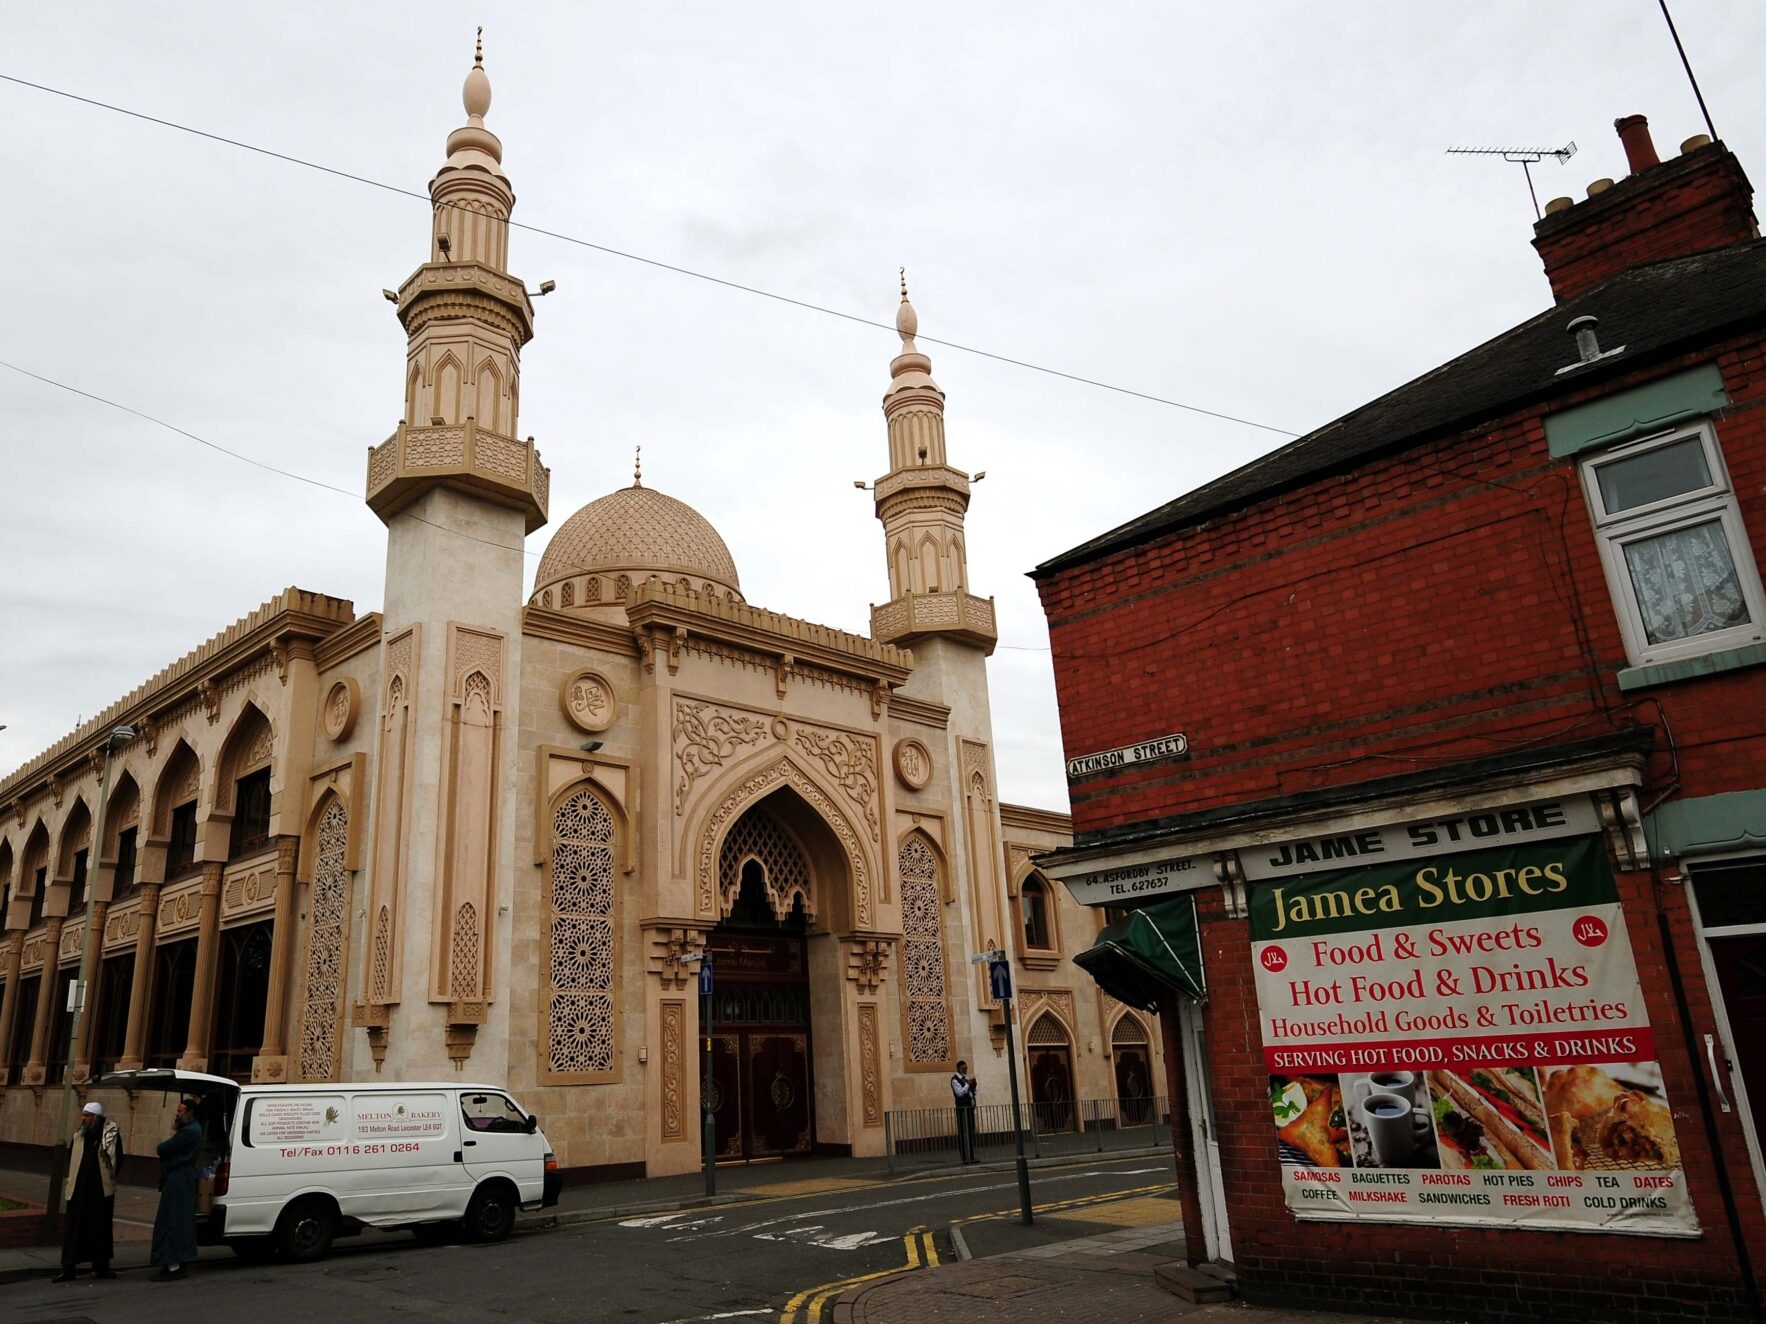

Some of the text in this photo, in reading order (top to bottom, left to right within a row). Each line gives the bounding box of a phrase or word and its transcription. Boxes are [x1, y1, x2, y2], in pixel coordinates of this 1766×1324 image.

[1071, 738, 1180, 775] ATKINSON STREET
[1269, 803, 1567, 868] JAME STORE
[1271, 862, 1568, 932] Jamea Stores
[1311, 922, 1542, 967] Food & Sweets
[1288, 957, 1589, 1007] Hot Food & Drinks
[1270, 998, 1628, 1038] Household Goods & Toiletries
[1274, 1036, 1637, 1068] SERVING HOT FOOD, SNACKS & DRINKS
[370, 1125, 386, 1133] Melton
[401, 1124, 422, 1132] Leicester
[411, 1111, 442, 1119] BAKERY
[280, 1143, 420, 1158] Tel/Fax 0116 261 0264
[1293, 1170, 1674, 1188] SAMOSAS BAGUETTES PAROTAS HOT PIES CHIPS TEA DATES
[1302, 1188, 1667, 1209] COFFEE MILKSHAKE SANDWICHES FRESH ROTI COLD DRINKS
